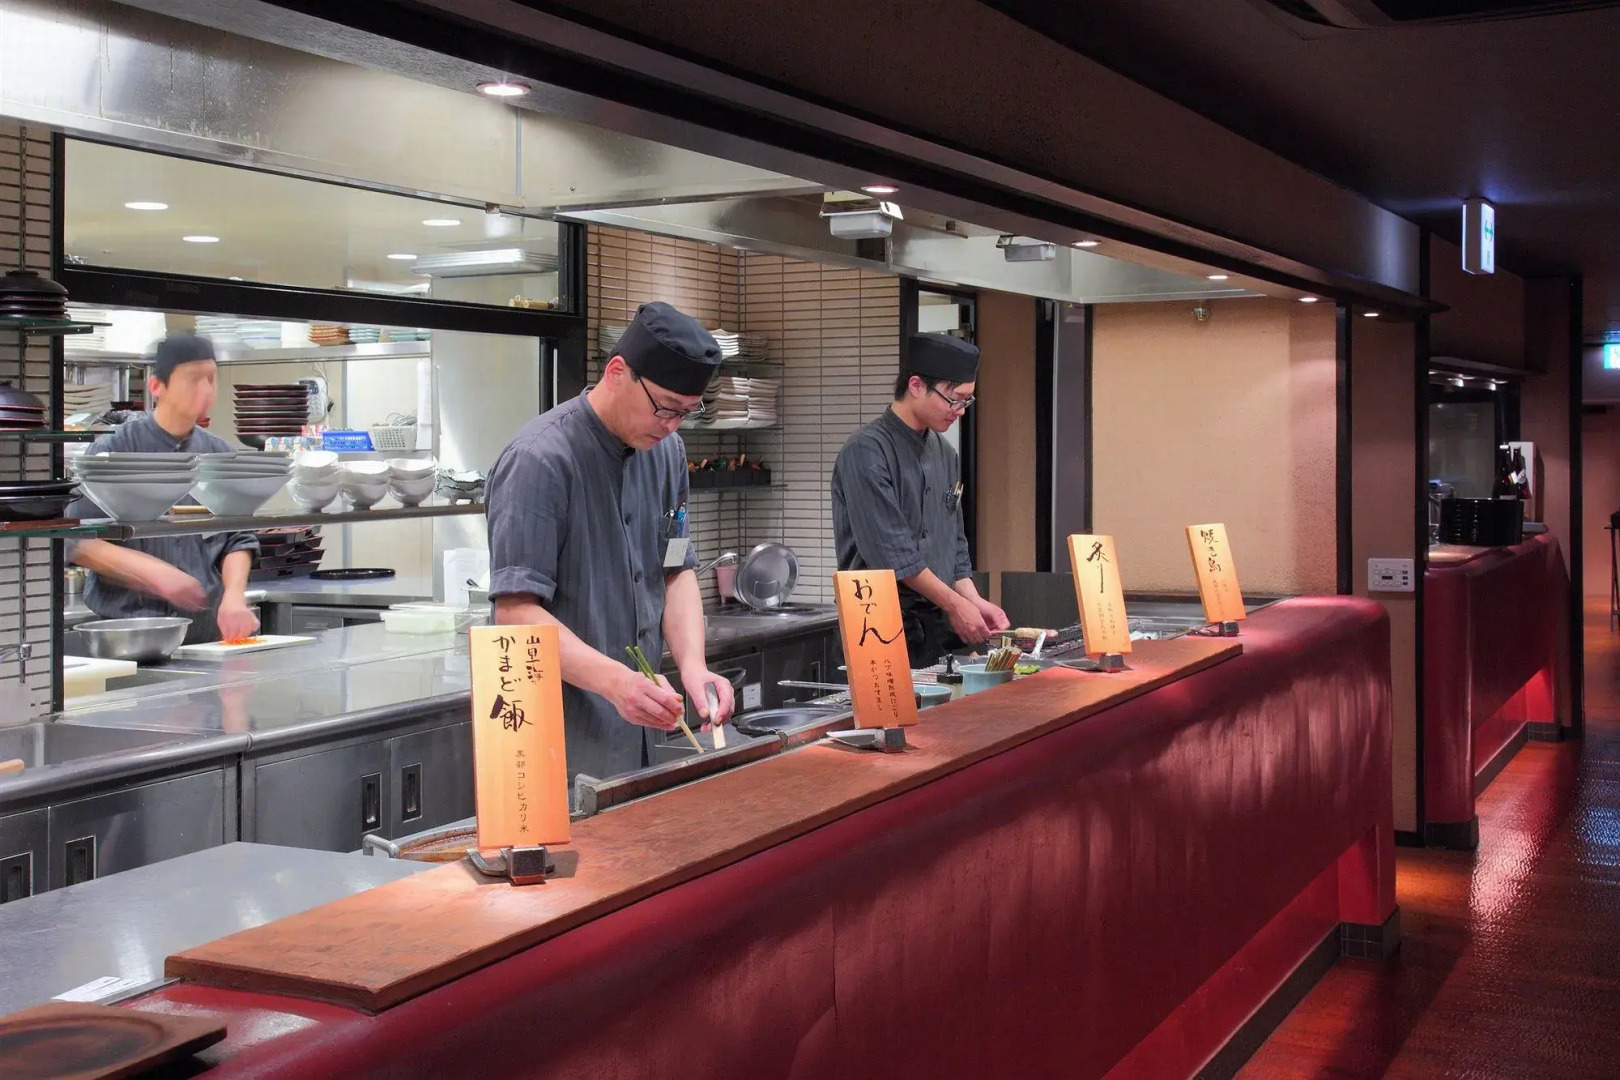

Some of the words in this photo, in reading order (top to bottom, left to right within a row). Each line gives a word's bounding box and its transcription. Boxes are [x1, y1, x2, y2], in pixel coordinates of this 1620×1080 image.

[852, 578, 904, 647] おでん
[490, 635, 533, 732] かまど飯
